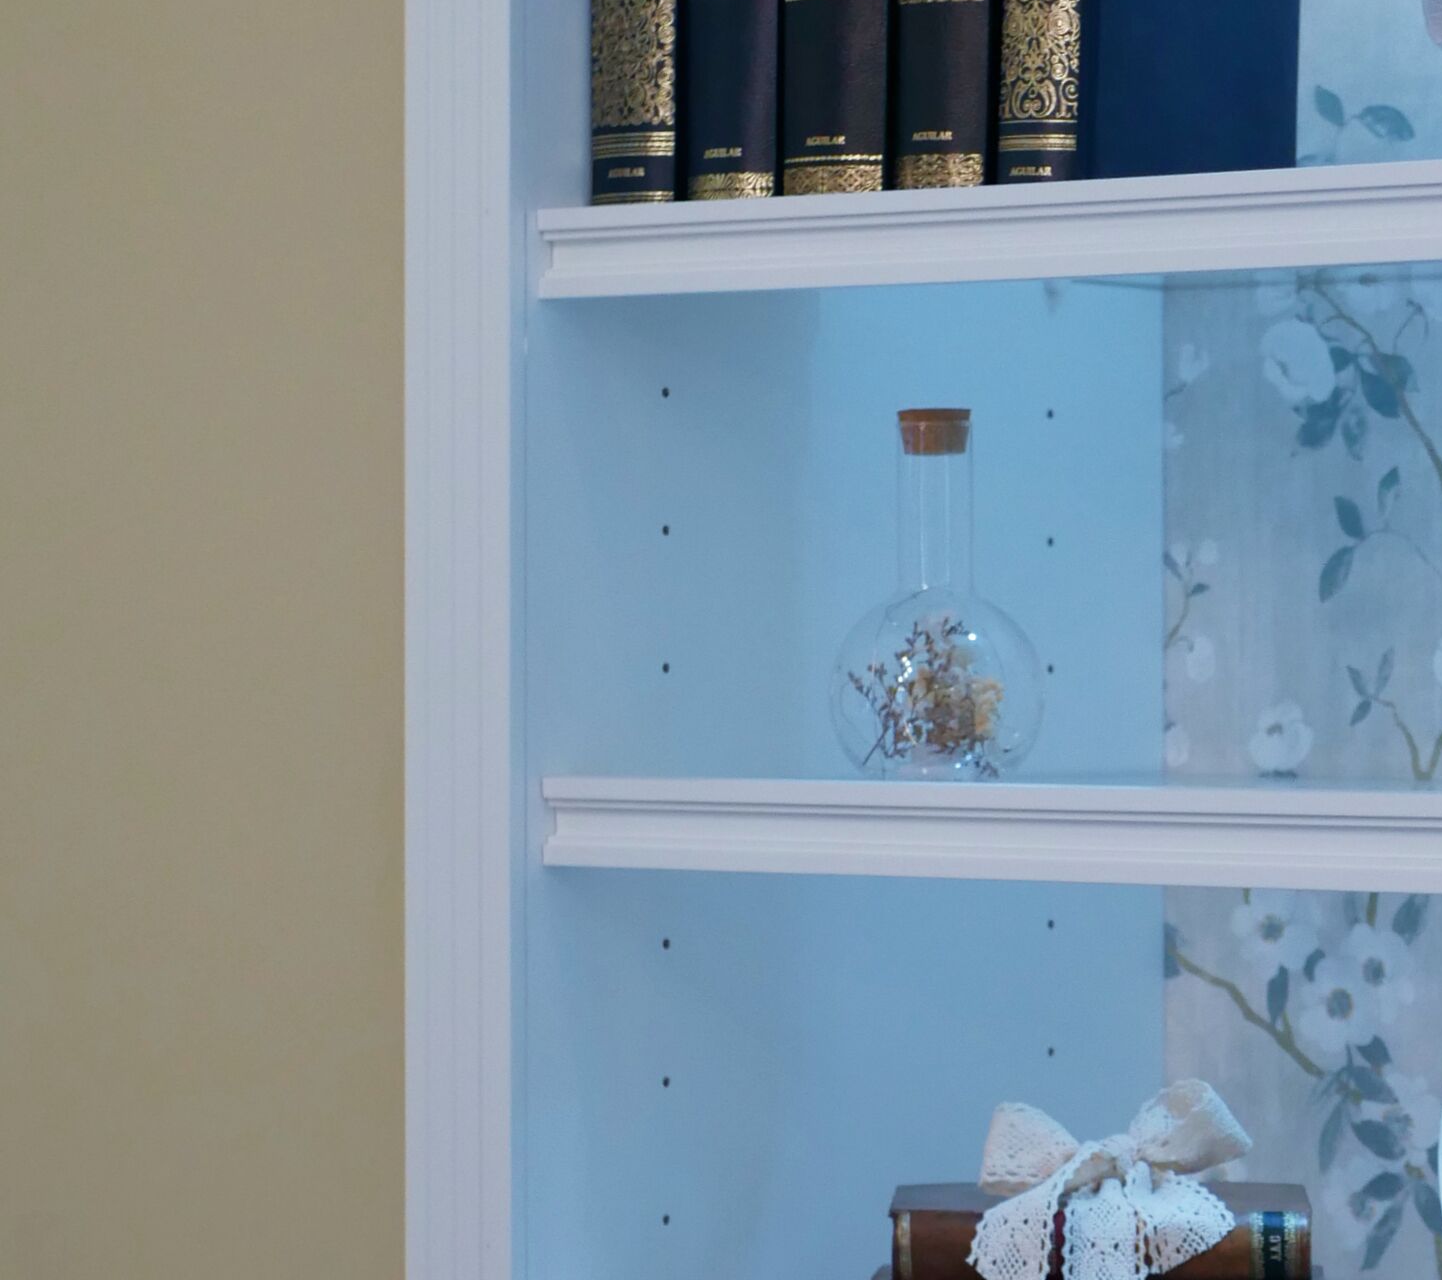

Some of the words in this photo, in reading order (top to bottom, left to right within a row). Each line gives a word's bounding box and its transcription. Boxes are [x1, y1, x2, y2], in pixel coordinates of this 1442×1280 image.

[805, 135, 846, 147] AGUILAR
[912, 131, 953, 141] AGUILAR
[1009, 166, 1053, 176] AGUILAR
